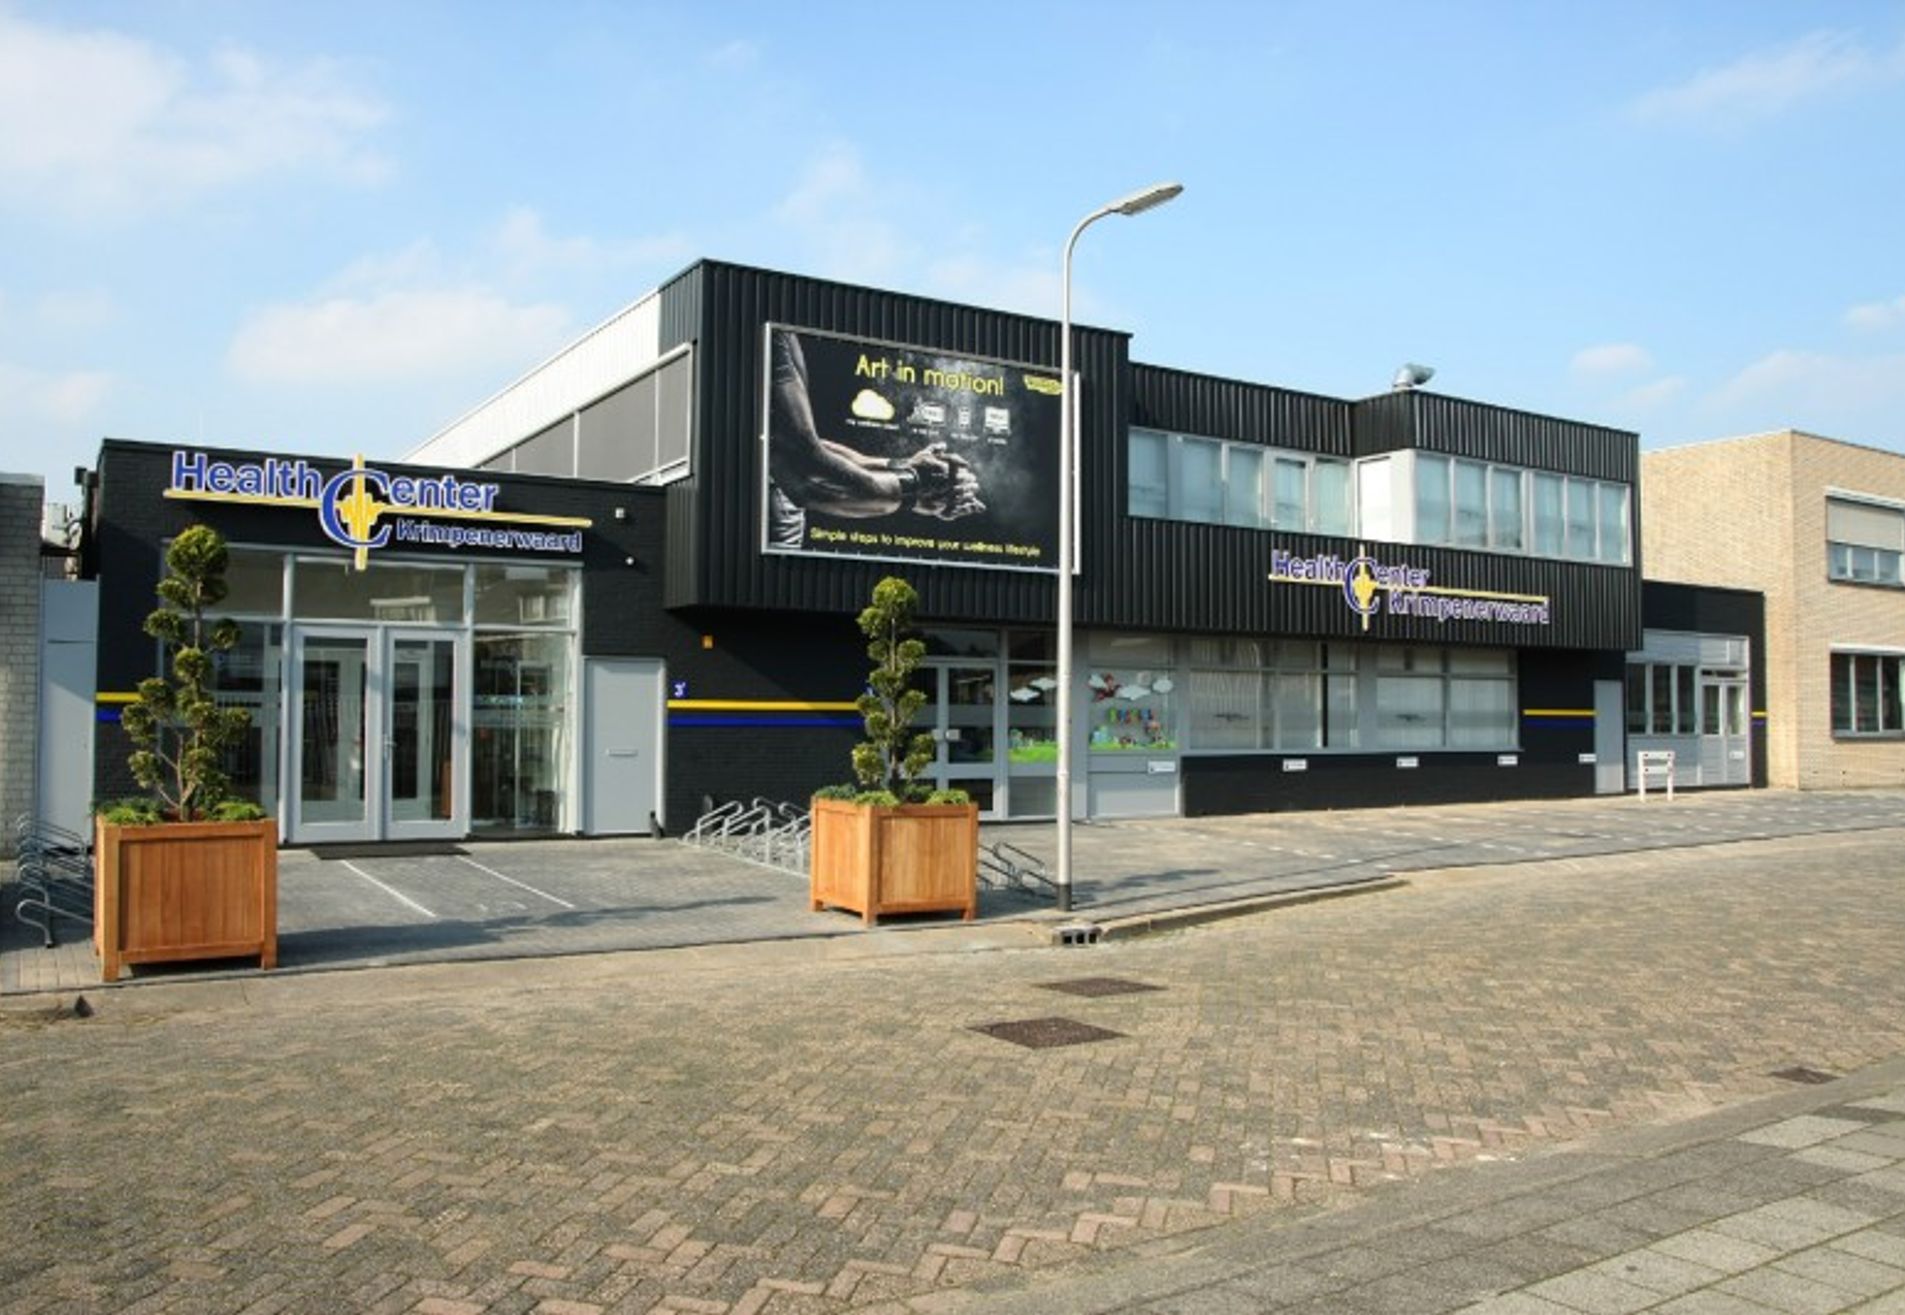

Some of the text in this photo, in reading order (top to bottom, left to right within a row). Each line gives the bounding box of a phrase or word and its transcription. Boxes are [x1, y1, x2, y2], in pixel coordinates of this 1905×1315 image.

[855, 354, 889, 379] Art
[896, 360, 916, 384] in
[923, 368, 1005, 396] motion!
[396, 518, 582, 553] Krimpenerwaard
[810, 527, 848, 543] Simple
[881, 533, 893, 546] to
[895, 535, 935, 549] improve
[937, 540, 960, 551] your
[1388, 590, 1550, 625] Krimpenerwaard
